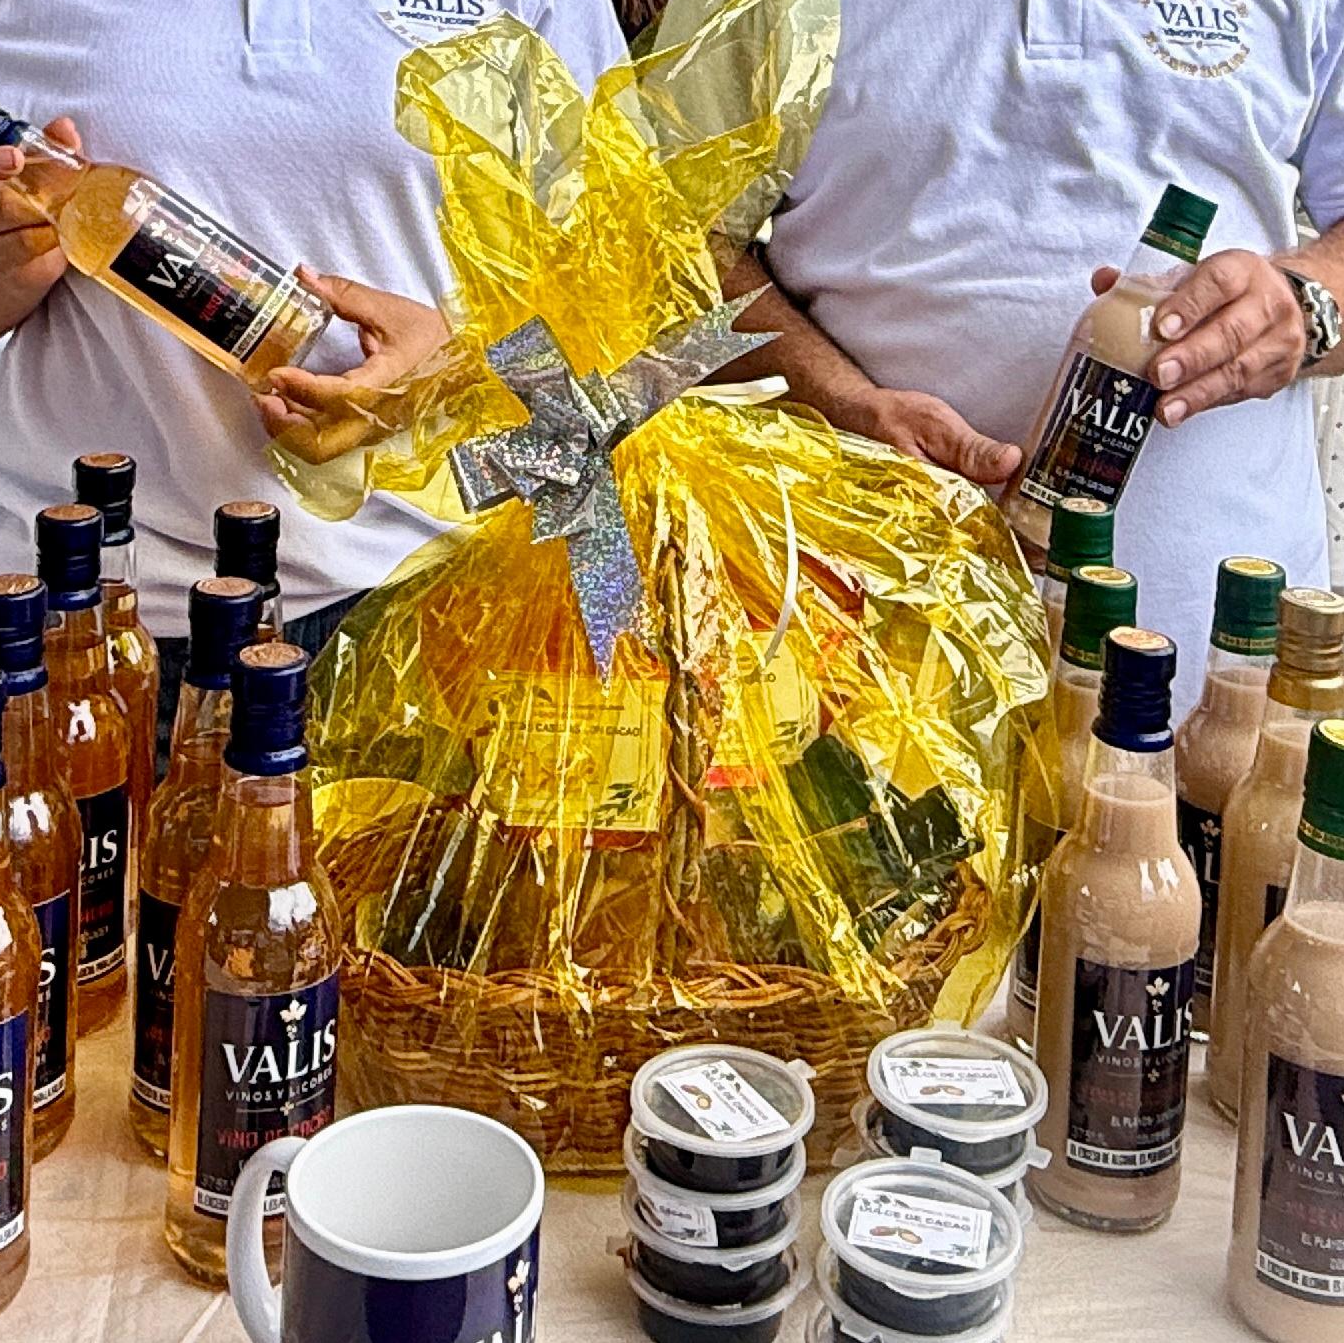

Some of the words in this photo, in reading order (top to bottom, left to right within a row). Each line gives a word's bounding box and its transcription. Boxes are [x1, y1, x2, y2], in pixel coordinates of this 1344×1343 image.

[1071, 387, 1150, 443] VALIS
[221, 1017, 337, 1085] VALIS
[225, 1088, 273, 1104] VINOS
[276, 1087, 286, 1101] Y
[1285, 1159, 1336, 1183] VINOS
